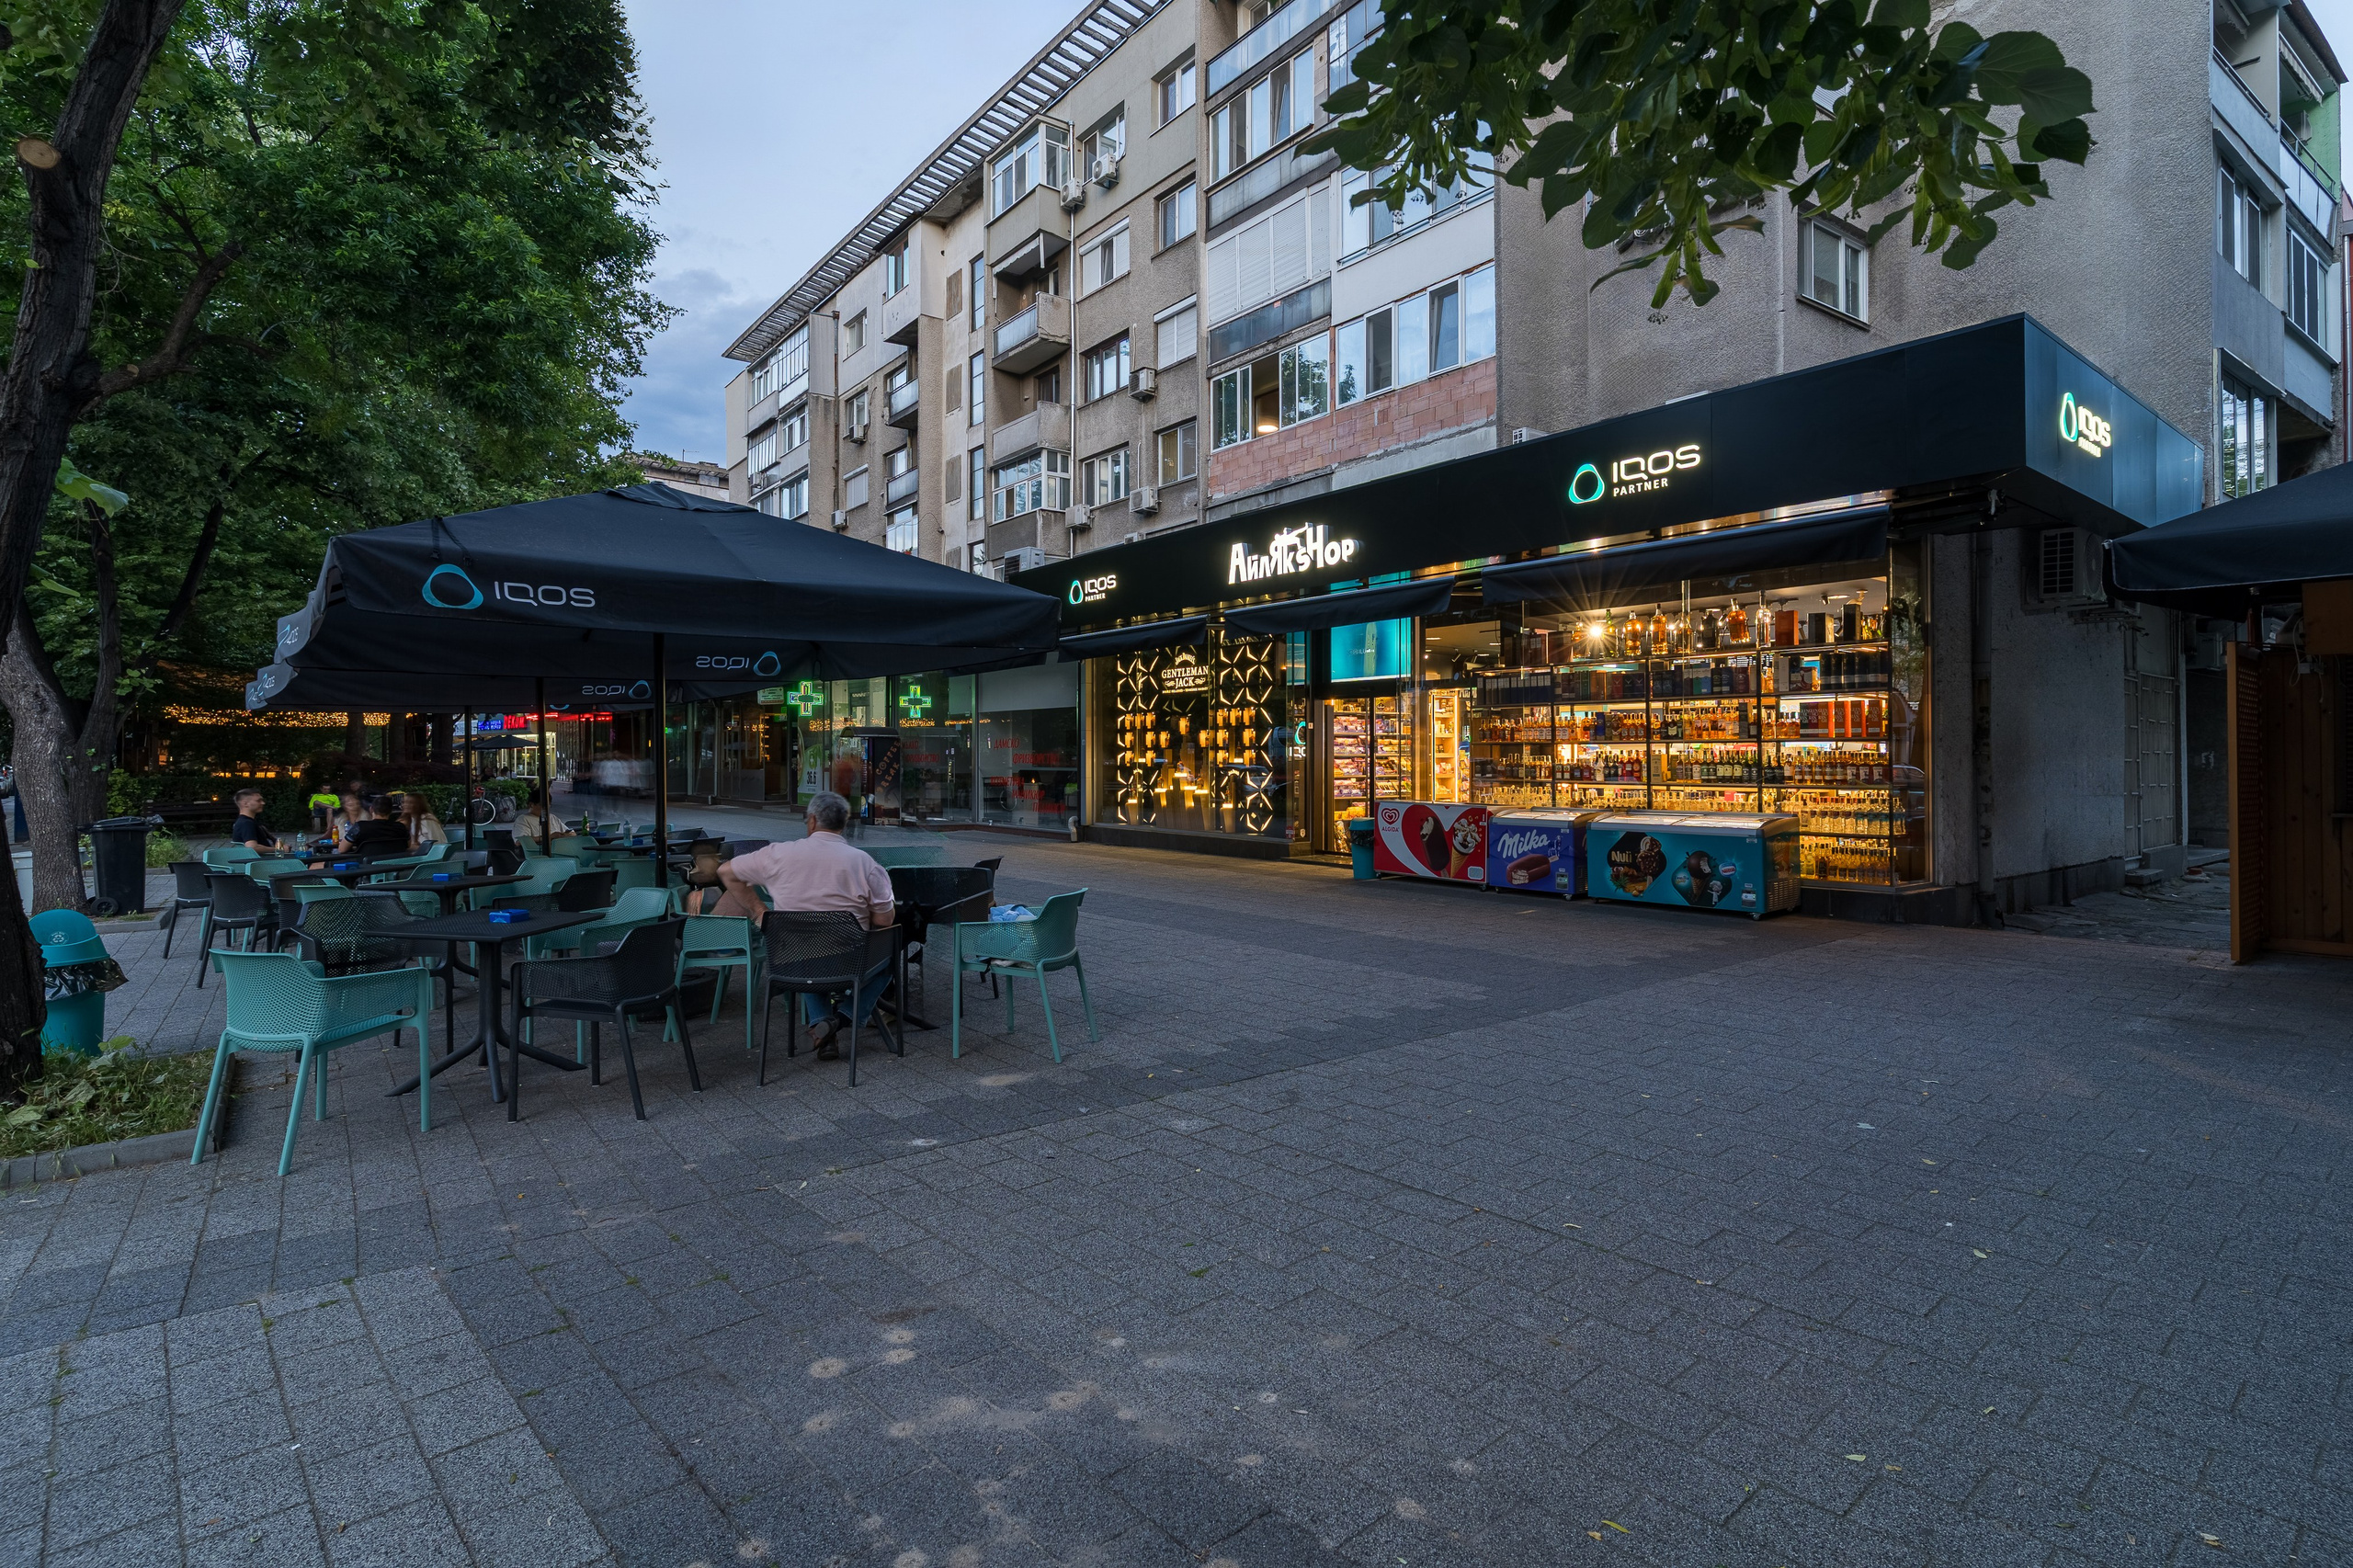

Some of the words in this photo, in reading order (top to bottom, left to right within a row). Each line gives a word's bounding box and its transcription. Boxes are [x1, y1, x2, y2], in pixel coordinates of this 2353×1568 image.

[2078, 406, 2111, 448] IQOS
[1612, 444, 1701, 483] IQOS
[1613, 477, 1669, 497] PARTNER
[1085, 574, 1117, 594] IQOS
[494, 581, 596, 608] IQOS
[1085, 592, 1107, 602] PARTNER
[1161, 665, 1210, 679] GENTLEMAN
[1175, 676, 1195, 688] JACK
[994, 737, 1021, 750] ДАМСКО
[875, 740, 901, 775] COFFEE
[1497, 829, 1551, 858] Milka
